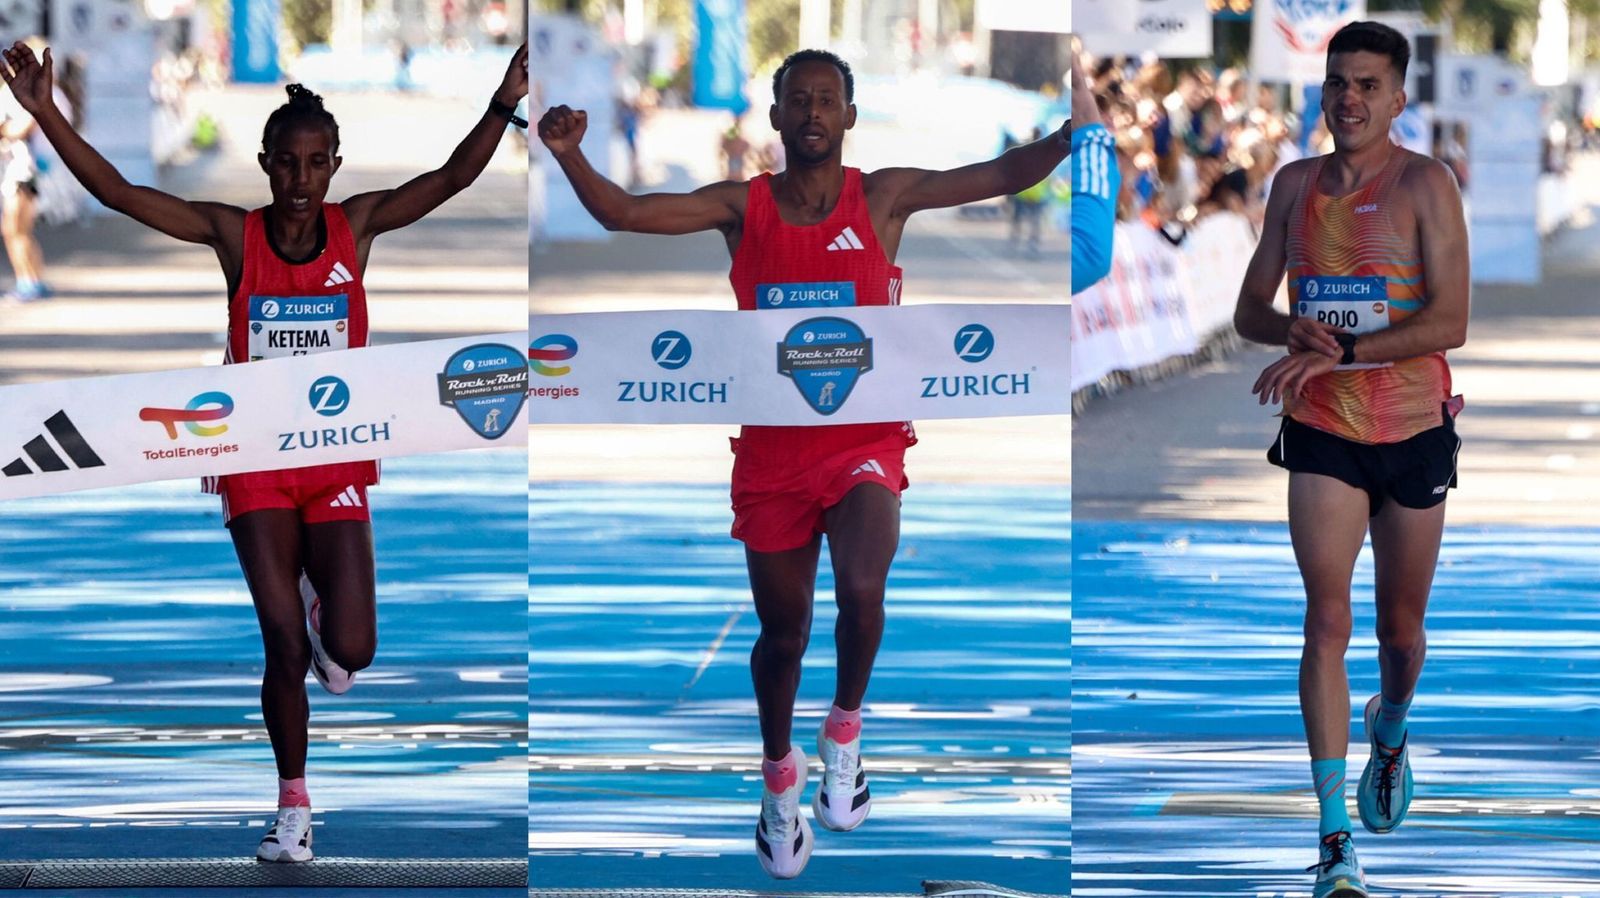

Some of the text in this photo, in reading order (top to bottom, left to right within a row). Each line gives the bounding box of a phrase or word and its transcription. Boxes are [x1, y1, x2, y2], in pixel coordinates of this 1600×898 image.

[790, 290, 839, 301] ZURICH
[1324, 284, 1371, 294] ZURICH
[285, 303, 334, 314] ZURICH
[268, 329, 331, 348] KETEMA
[817, 332, 846, 340] ZURICH
[477, 357, 507, 367] ZURICH
[455, 383, 521, 396] RUNNING SERIES
[920, 373, 1030, 398] ZURICH
[617, 382, 727, 403] ZURICH
[278, 422, 390, 451] ZURICH
[143, 443, 239, 460] TotalEnergies
